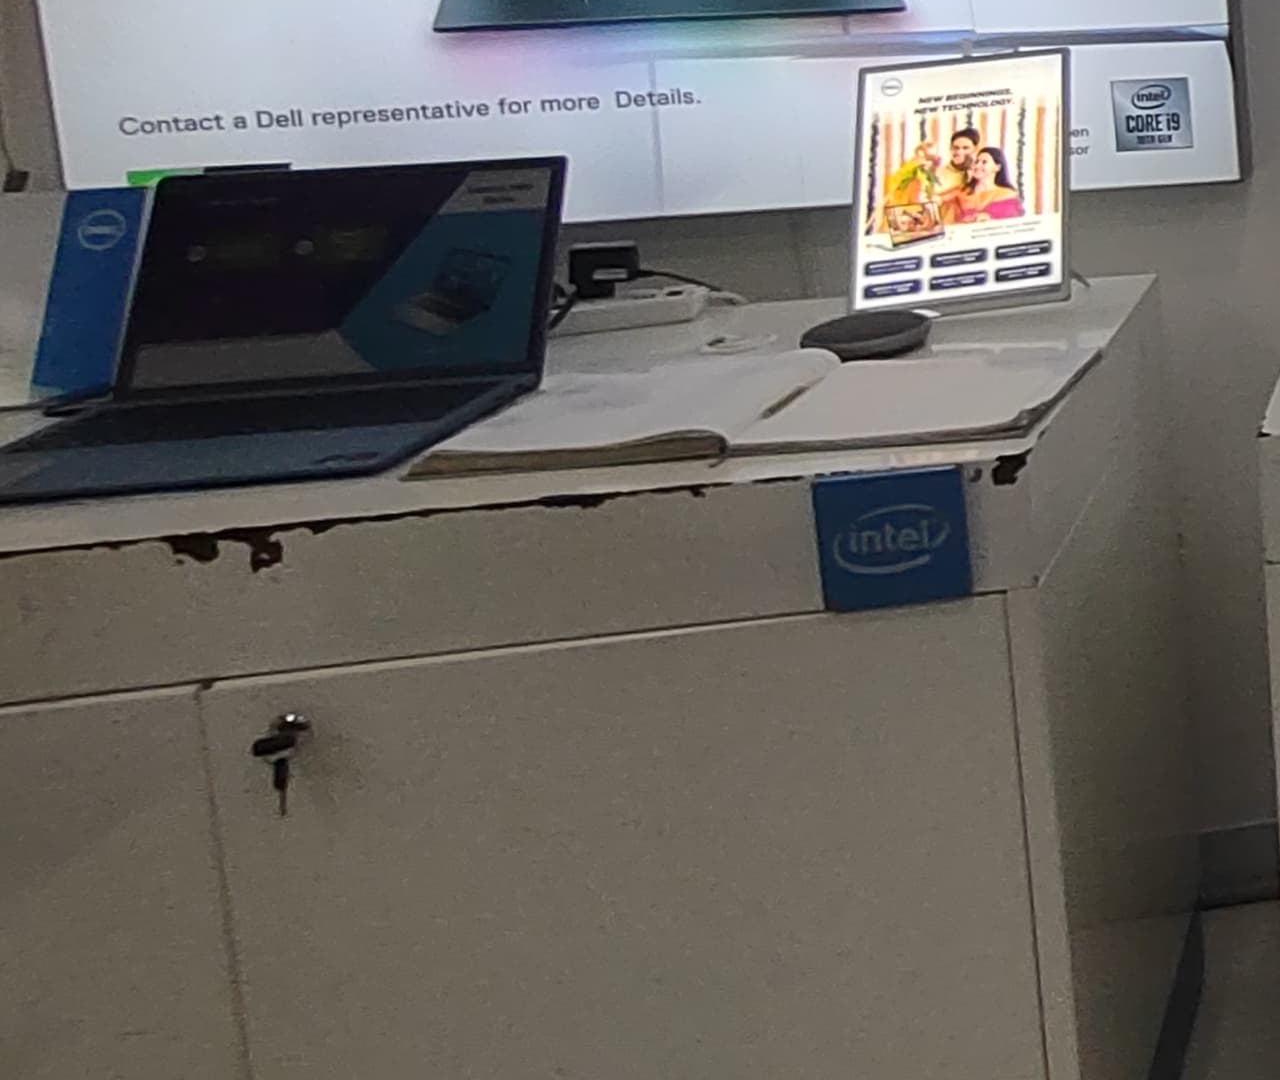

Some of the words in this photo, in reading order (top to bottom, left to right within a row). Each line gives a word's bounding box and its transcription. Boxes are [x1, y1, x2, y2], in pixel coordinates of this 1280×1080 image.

[1136, 89, 1165, 102] intel
[118, 113, 225, 136] Contact
[233, 116, 247, 130] a
[256, 108, 303, 129] Dell
[311, 99, 489, 128] representative
[498, 96, 532, 115] for
[539, 94, 600, 112] more
[615, 88, 702, 109] Details.
[1125, 113, 1163, 133] CORE
[1166, 112, 1181, 132] i9
[850, 520, 929, 554] intel
